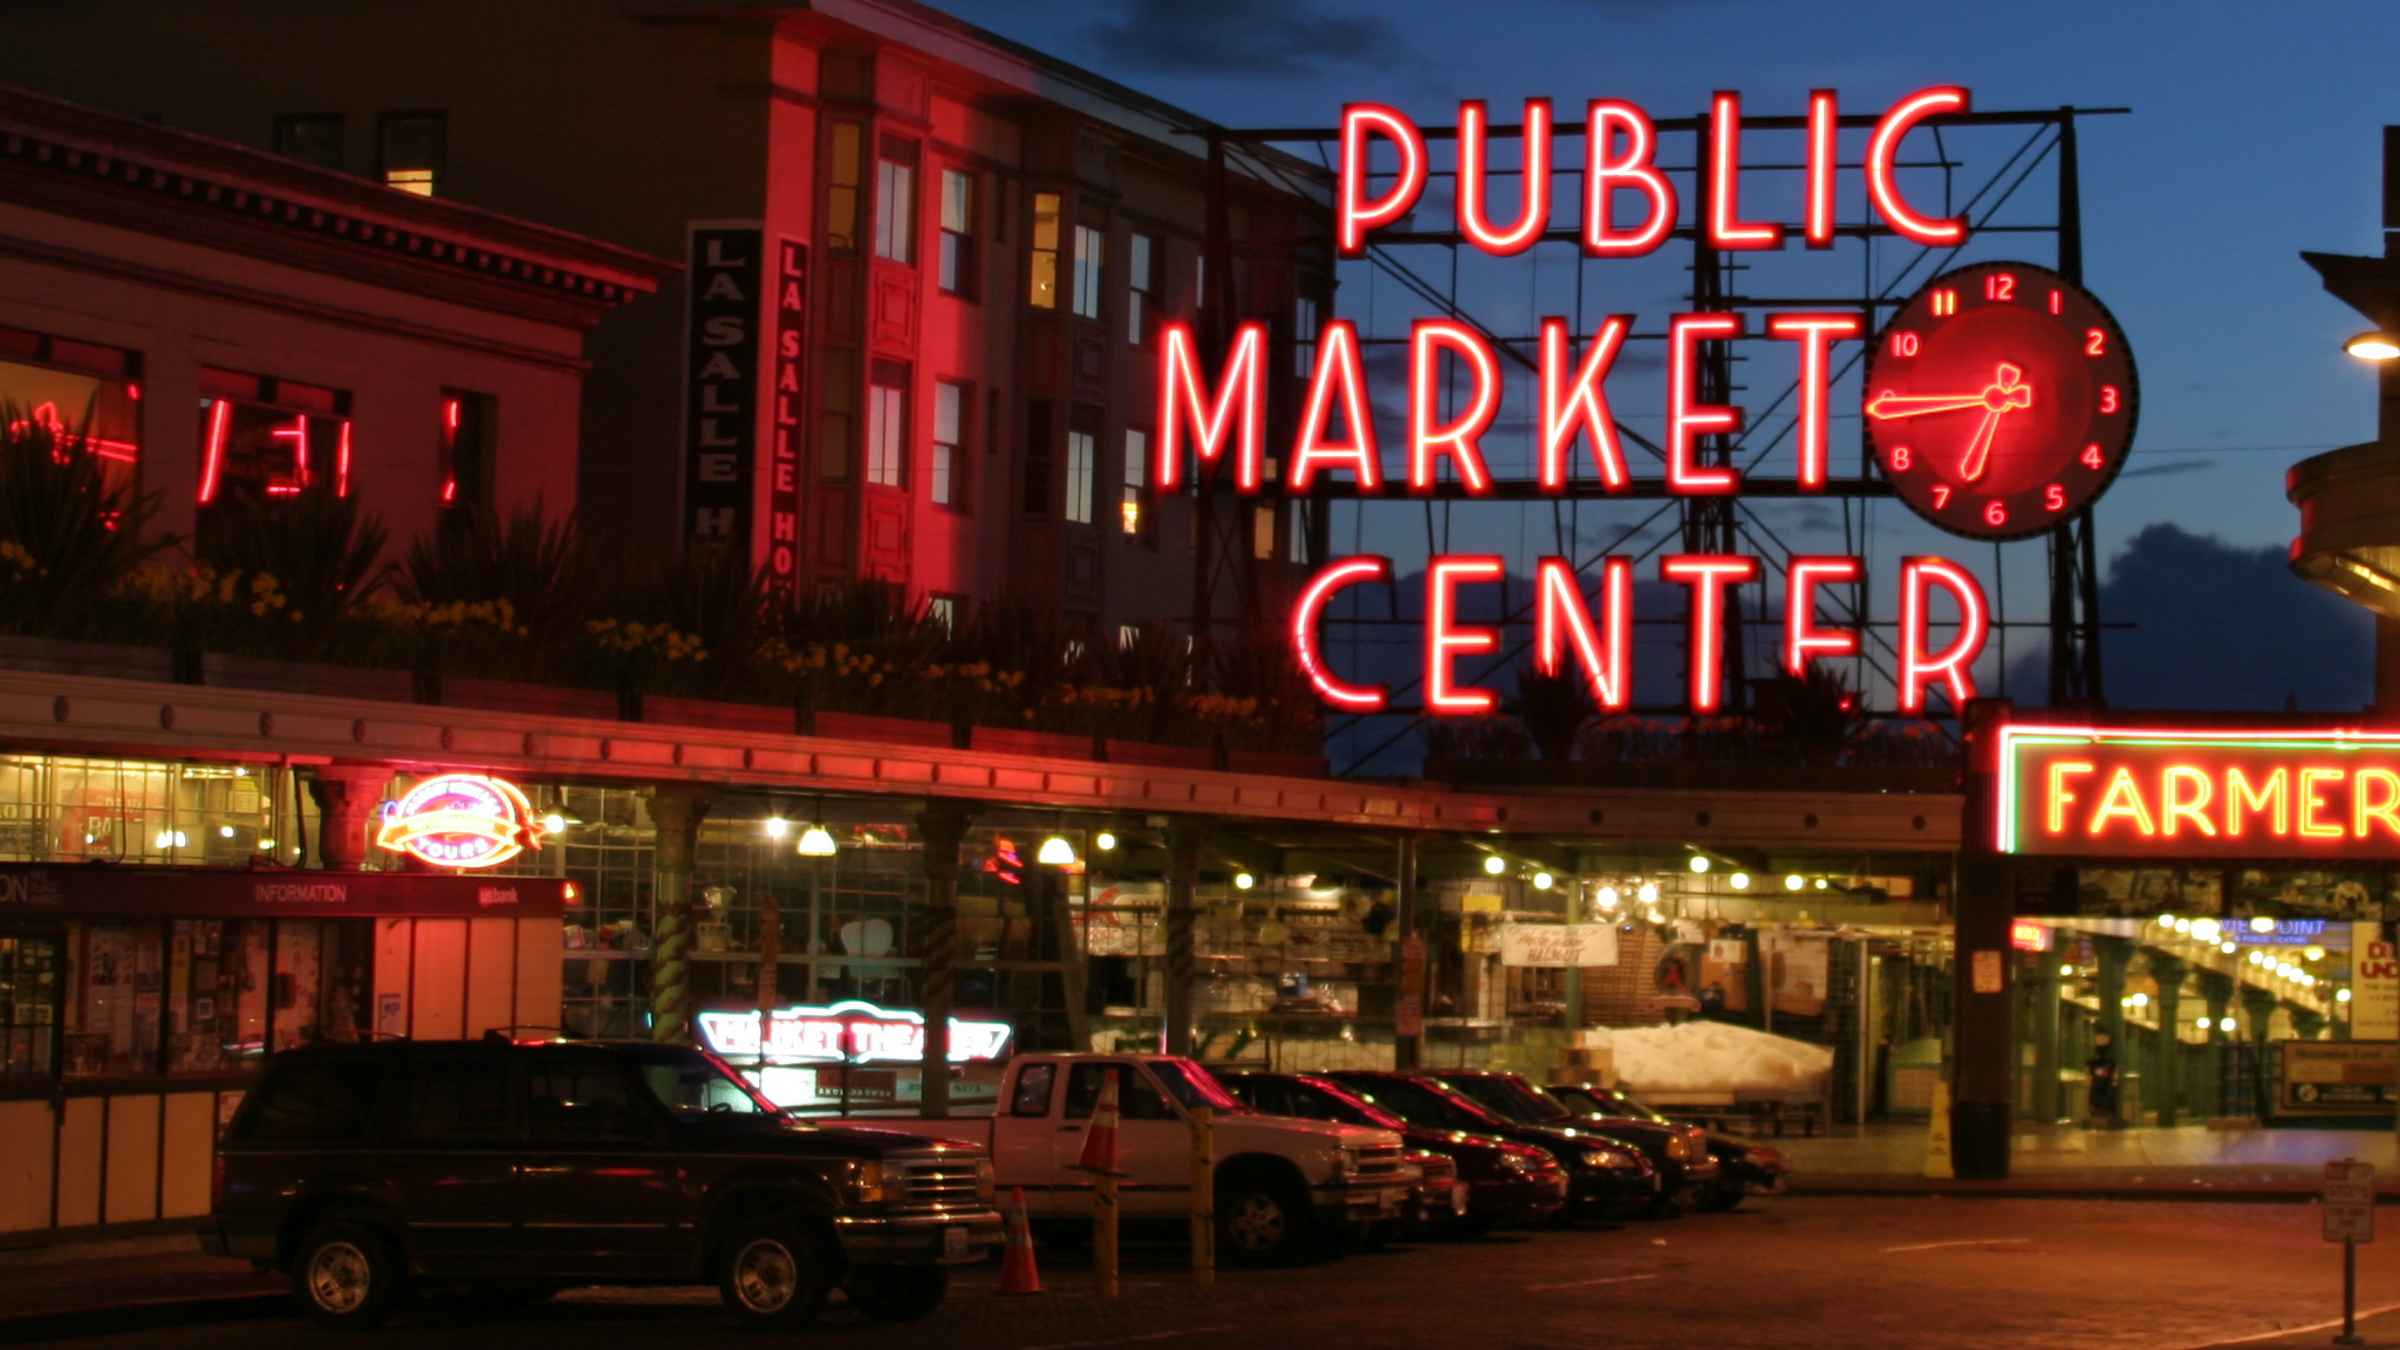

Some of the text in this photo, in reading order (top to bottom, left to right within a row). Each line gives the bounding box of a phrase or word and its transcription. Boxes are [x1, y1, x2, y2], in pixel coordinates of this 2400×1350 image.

[1339, 86, 1964, 255] PUBLIC
[703, 239, 746, 300] LA
[782, 247, 803, 311] LA
[1986, 274, 2016, 301] 12
[1933, 291, 1956, 316] 11
[2051, 291, 2062, 315] 1
[1893, 333, 1920, 357] 10
[2086, 331, 2105, 356] 2
[700, 317, 745, 481] SALLE
[776, 330, 801, 492] SALLE
[1156, 314, 1859, 493] MARKET
[2101, 387, 2119, 414] 3
[1891, 447, 1911, 471] 8
[2082, 444, 2102, 470] 4
[1932, 487, 1951, 510] 7
[2046, 485, 2065, 511] 5
[1986, 502, 2007, 526] 6
[1290, 555, 1987, 714] CENTER
[2046, 760, 2400, 838] FARMER
[255, 883, 347, 902] INFORMATION
